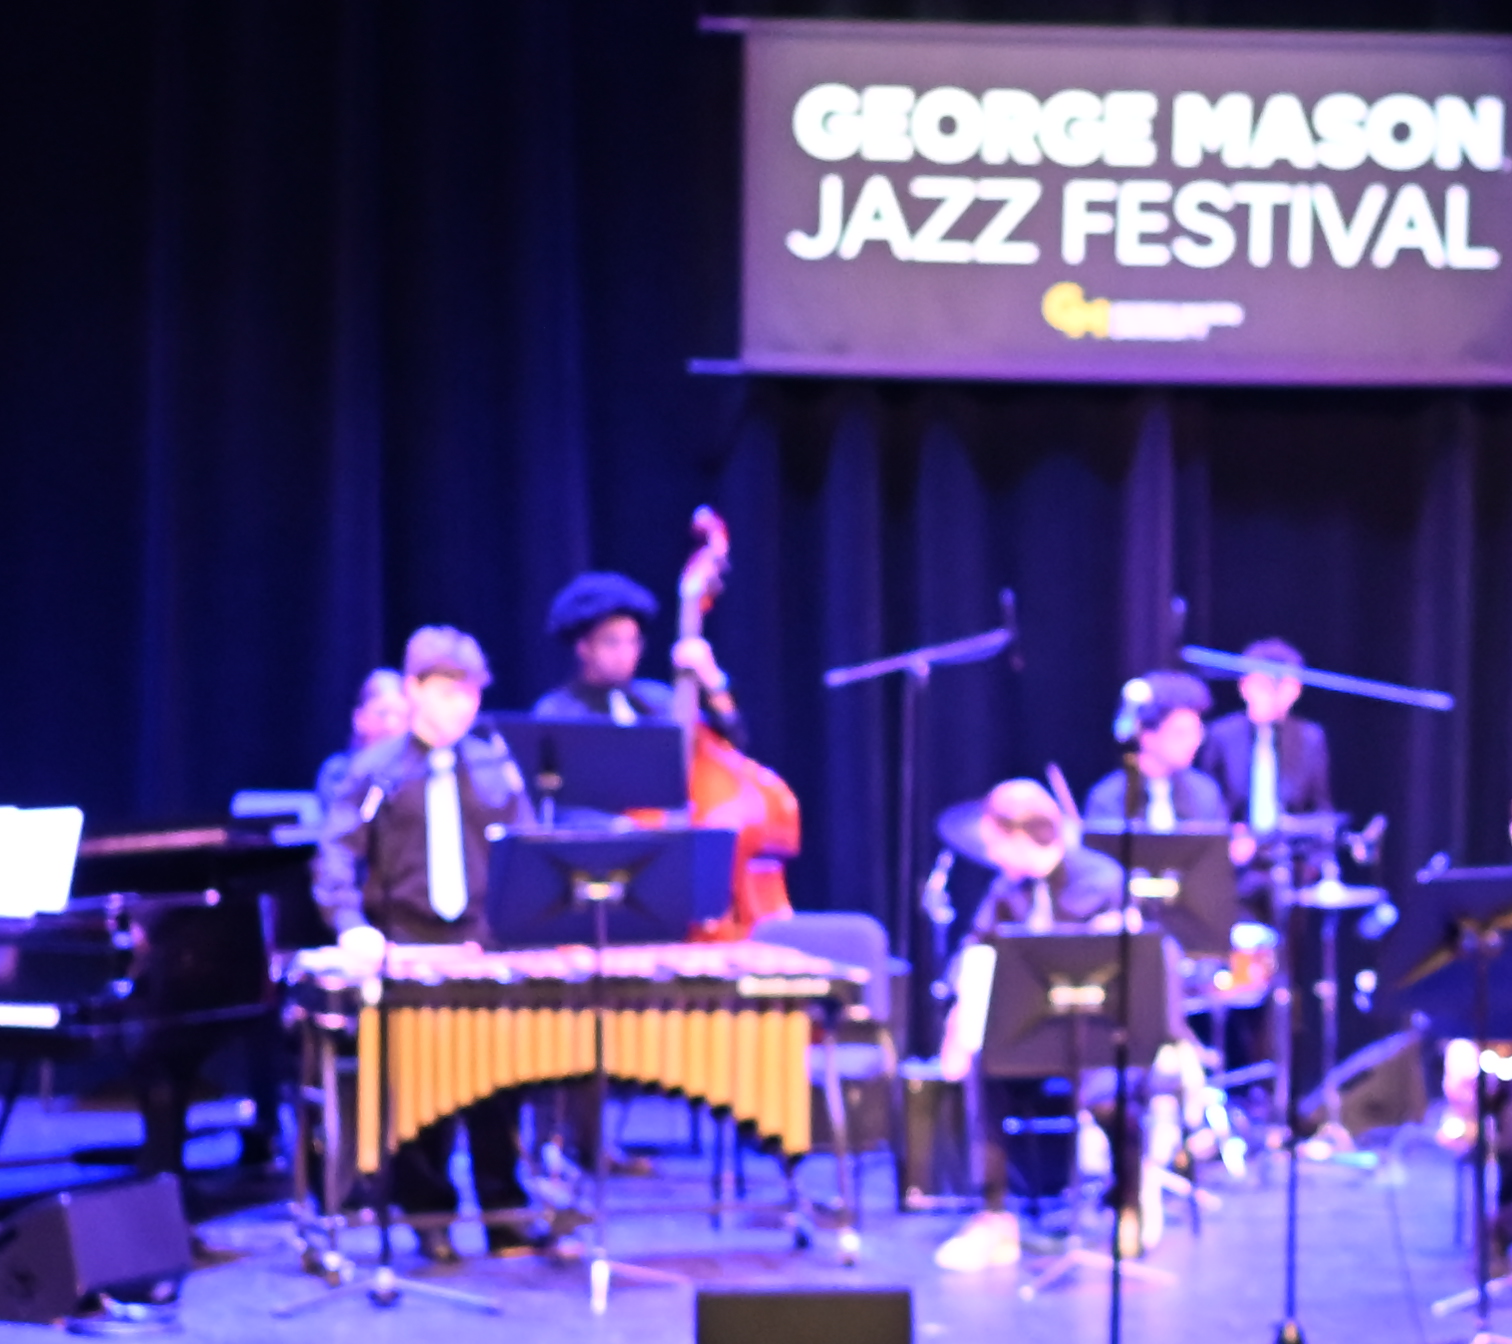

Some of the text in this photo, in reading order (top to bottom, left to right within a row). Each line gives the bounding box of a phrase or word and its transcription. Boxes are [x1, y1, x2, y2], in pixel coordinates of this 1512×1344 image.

[793, 84, 1505, 170] GEORGE MASON
[785, 175, 1500, 268] JAZZ FESTIVAL
